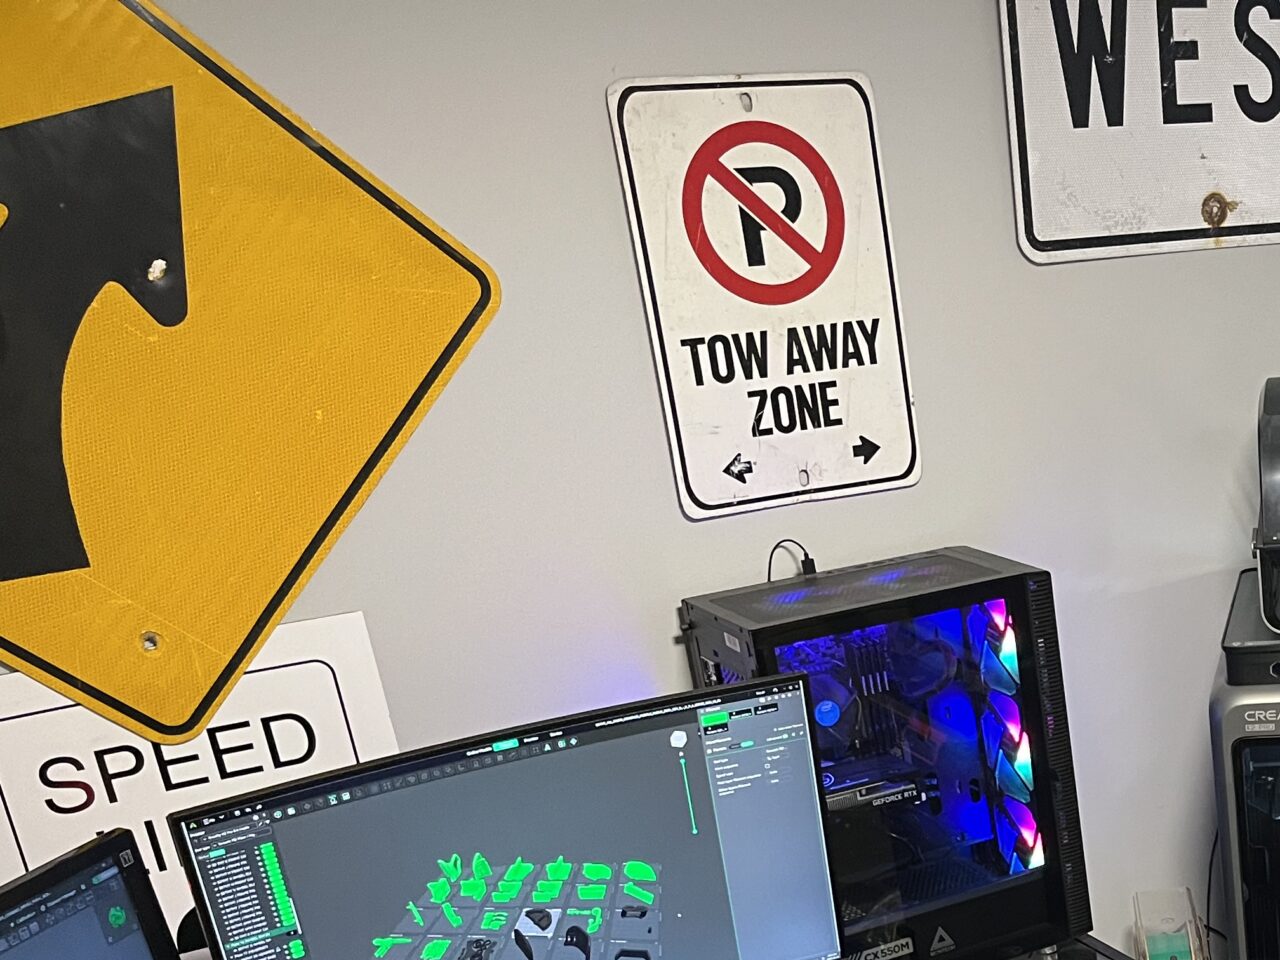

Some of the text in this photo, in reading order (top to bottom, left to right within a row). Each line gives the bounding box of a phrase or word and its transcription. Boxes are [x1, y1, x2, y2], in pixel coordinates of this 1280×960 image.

[680, 318, 880, 387] TOW AWAY
[747, 380, 843, 438] ZONE
[38, 713, 317, 815] SPEED
[872, 789, 918, 806] GEFORCE RTX
